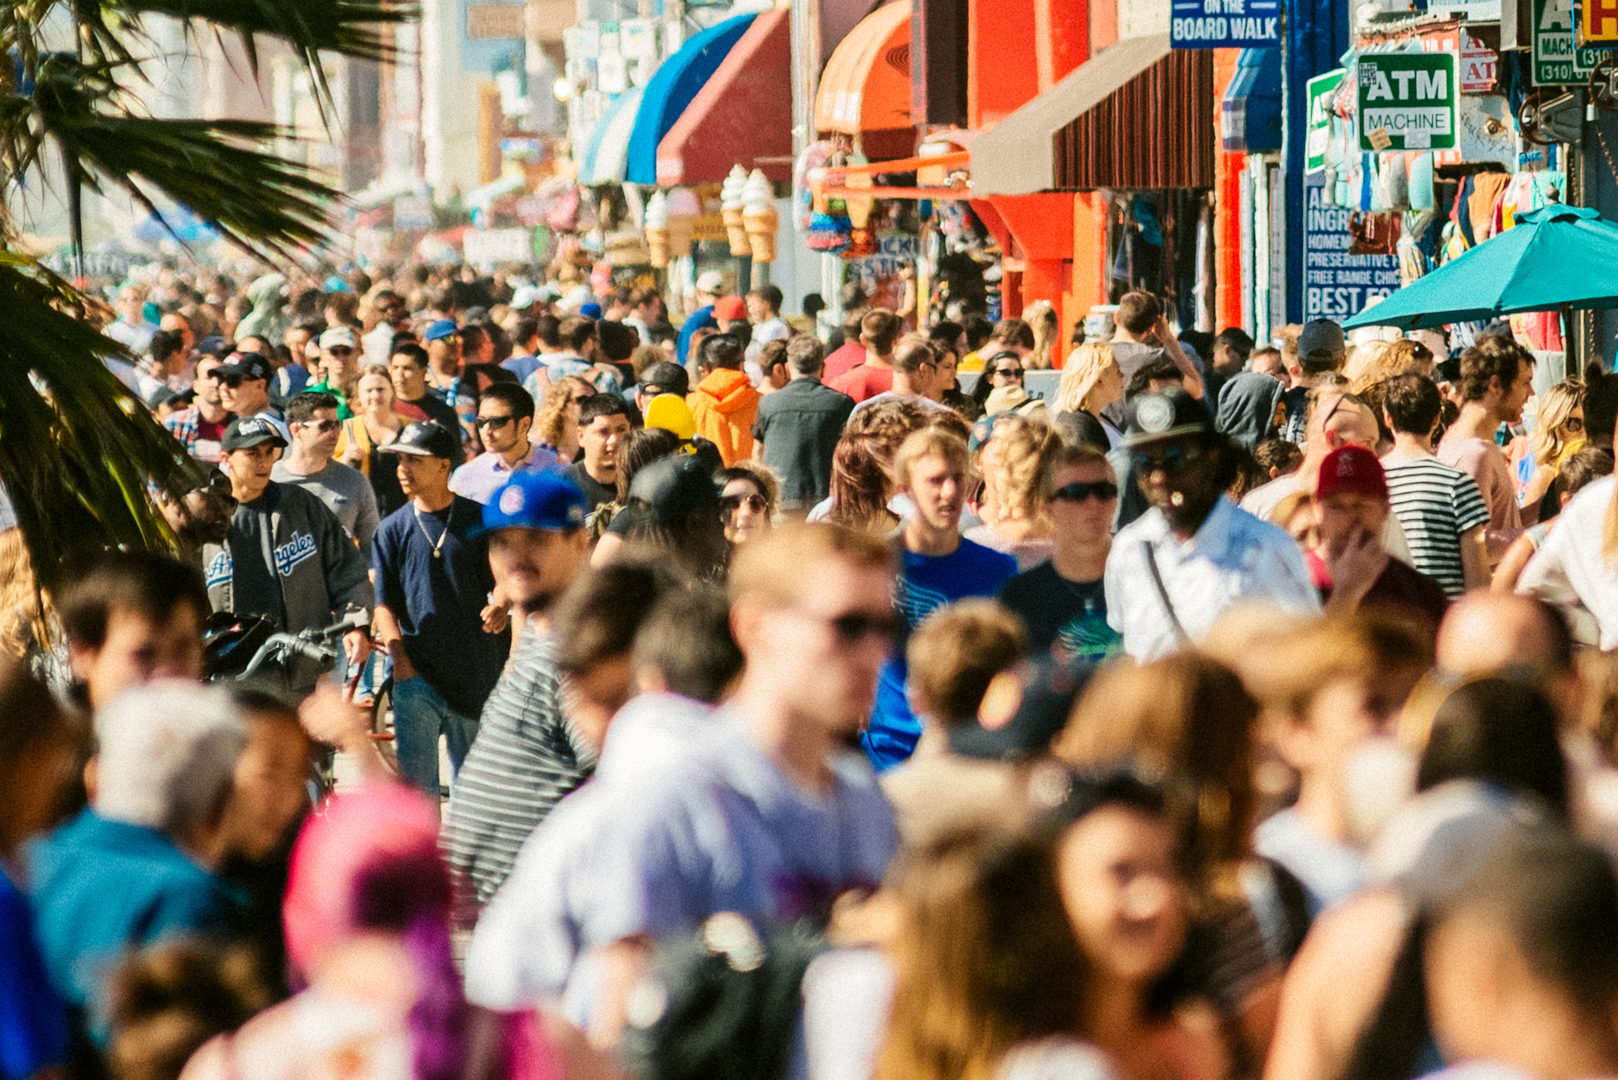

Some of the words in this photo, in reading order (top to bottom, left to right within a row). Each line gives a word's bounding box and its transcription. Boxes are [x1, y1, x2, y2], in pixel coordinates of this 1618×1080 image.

[1173, 17, 1229, 41] BOARD
[1230, 16, 1277, 41] WALK
[1366, 69, 1448, 101] ATM
[1368, 113, 1446, 130] MACHINE
[1307, 252, 1390, 268] PRESERVATIVE
[1308, 270, 1334, 285] FREE
[1336, 270, 1374, 286] RANGE
[1307, 287, 1361, 315] BEST
